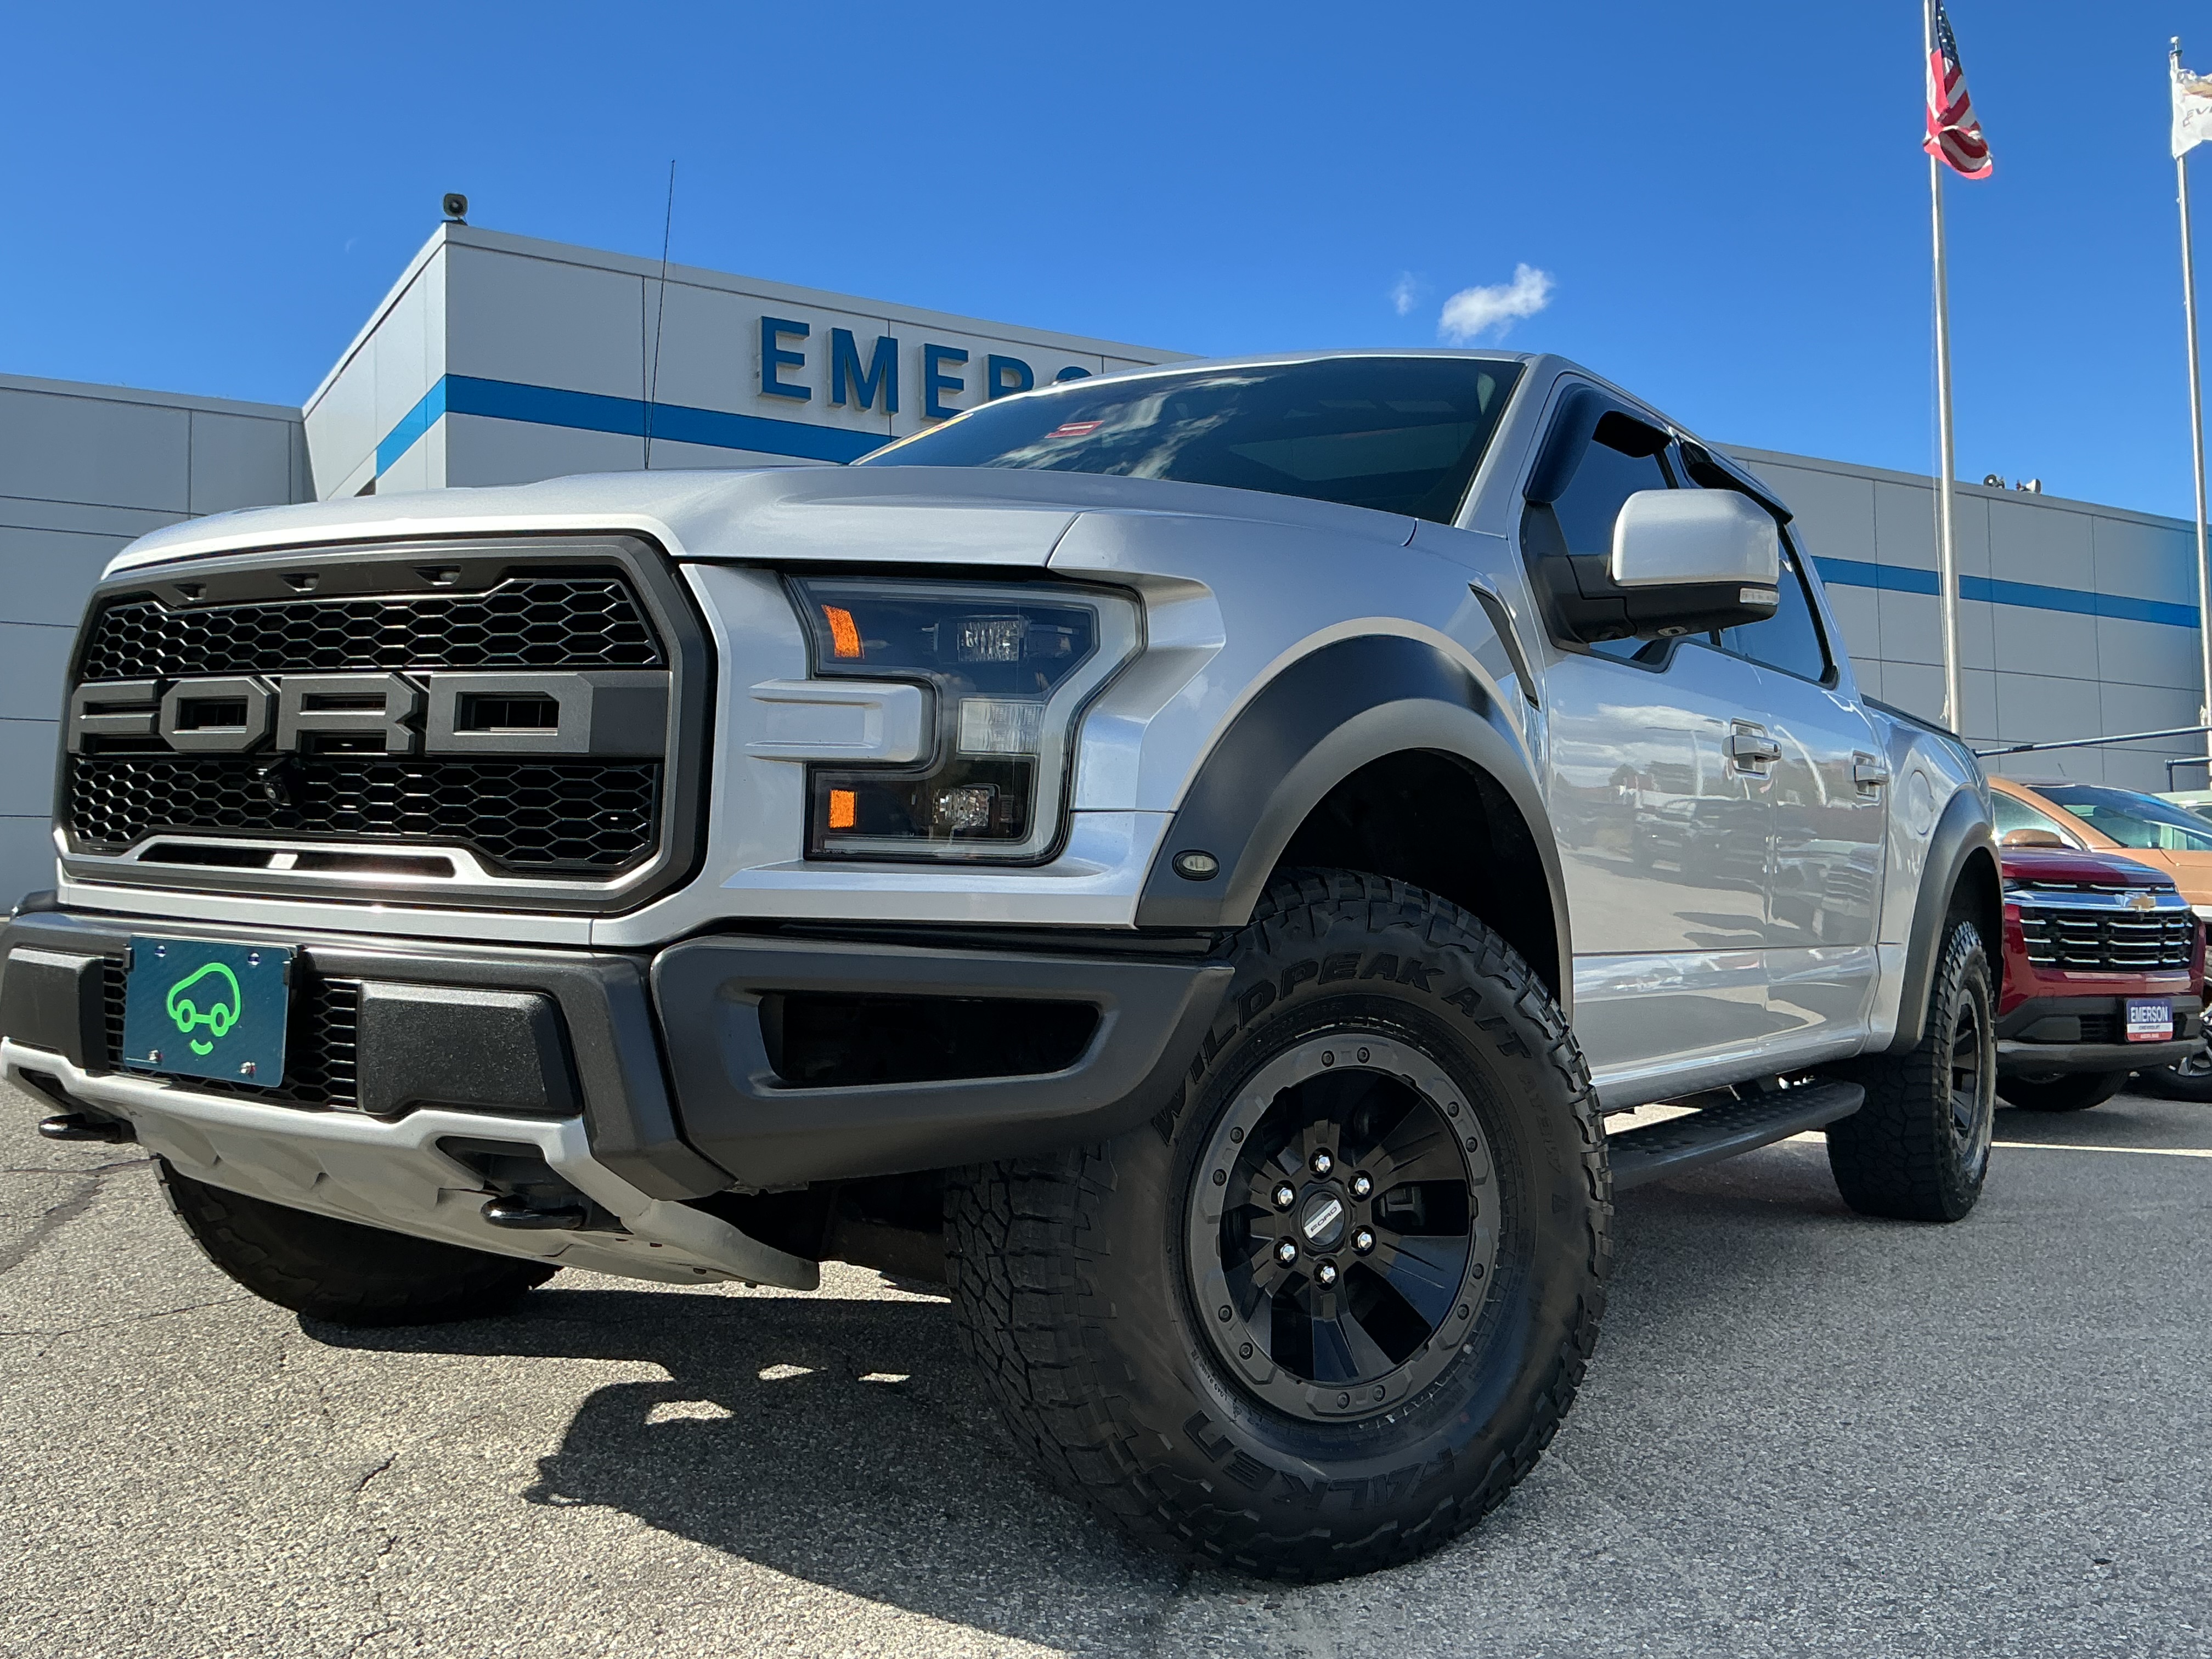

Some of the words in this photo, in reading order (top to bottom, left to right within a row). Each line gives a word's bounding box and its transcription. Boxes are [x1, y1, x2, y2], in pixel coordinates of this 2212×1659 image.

[760, 315, 1094, 421] EMER
[68, 672, 593, 755] FORD
[1152, 952, 1444, 1146] WILDPEAK
[2130, 1006, 2168, 1022] EMERSON
[1310, 1206, 1338, 1233] FORD
[1183, 1409, 1457, 1510] FALKEN
